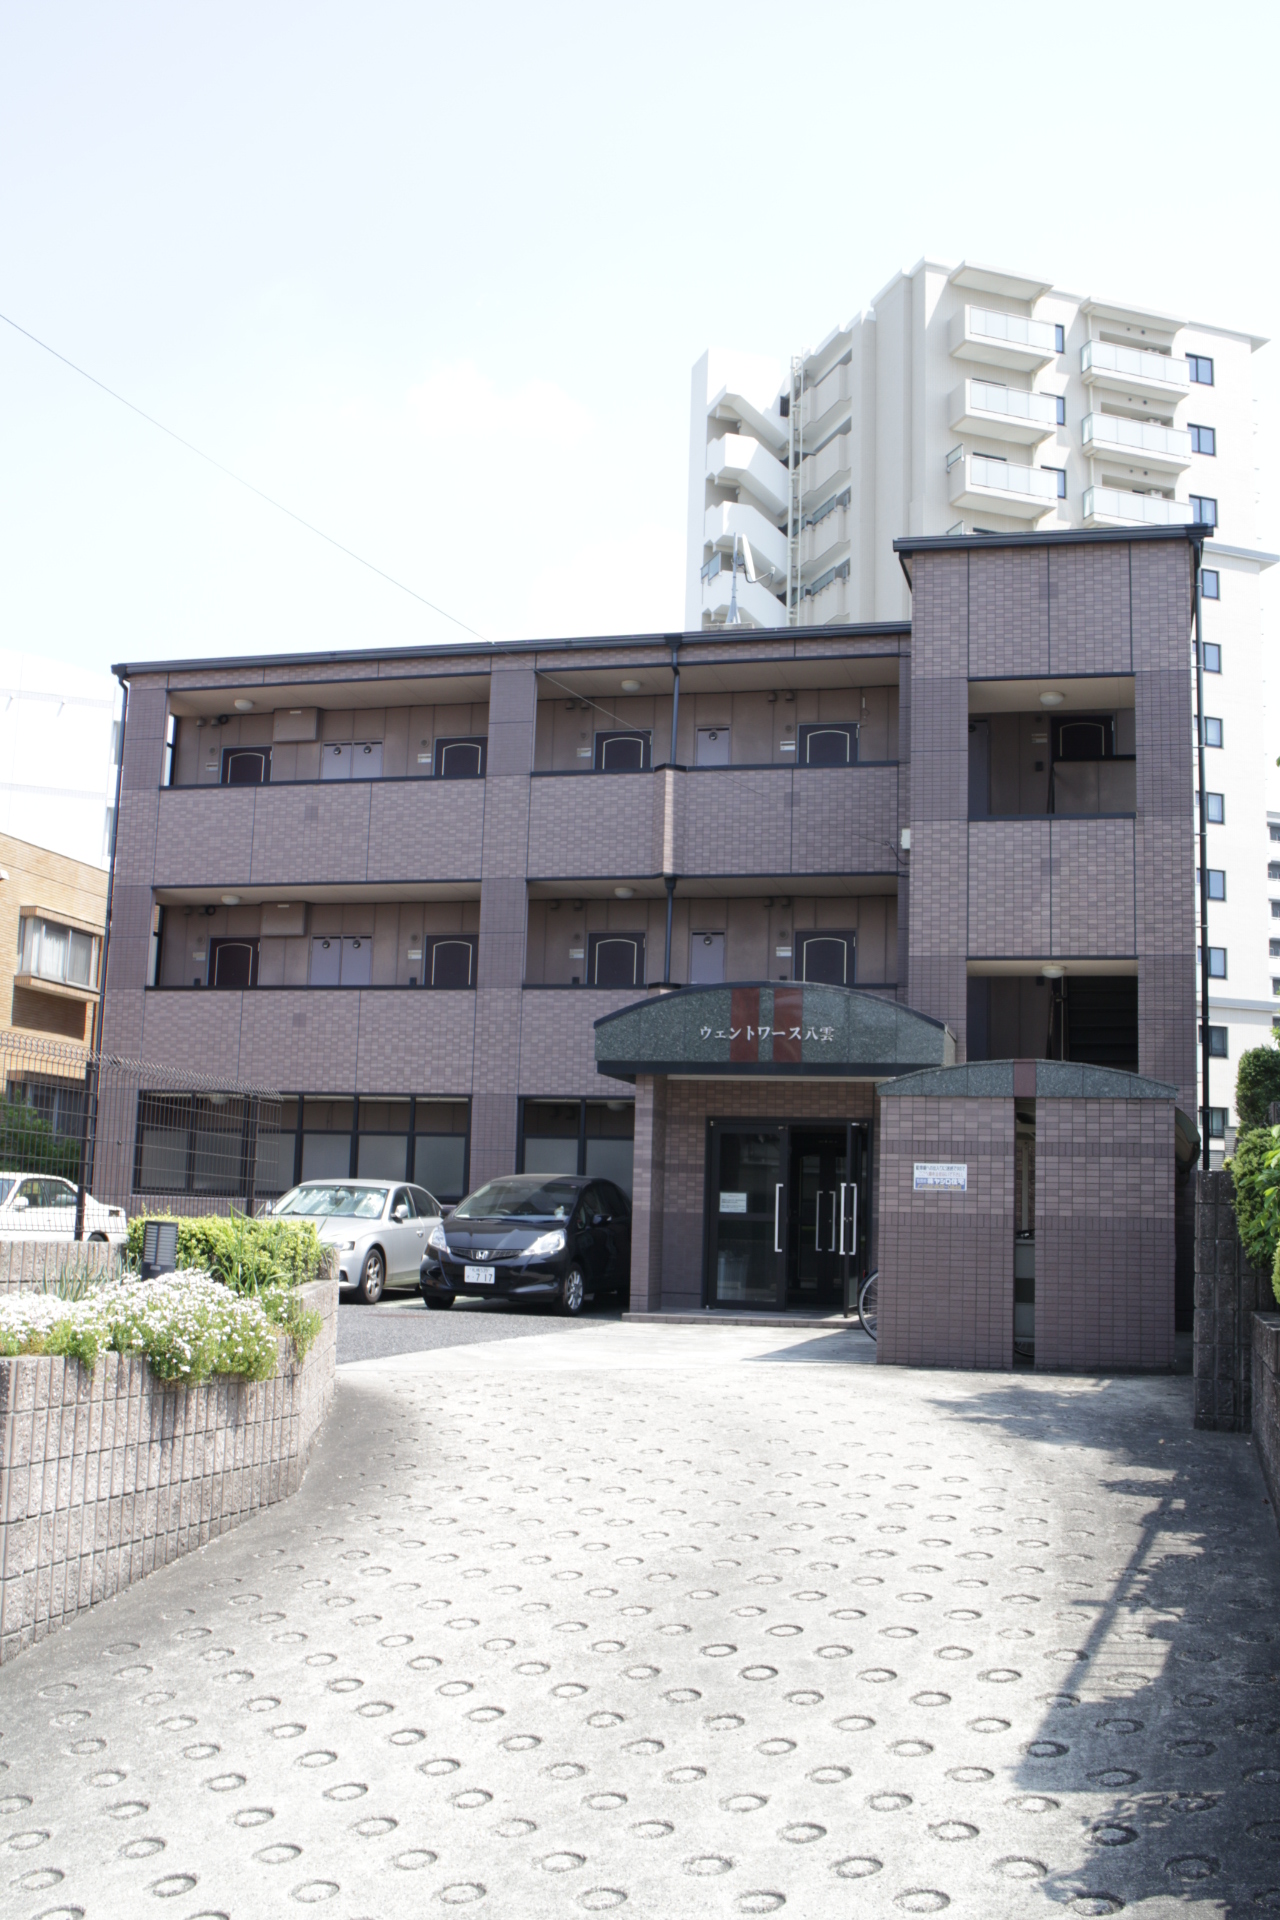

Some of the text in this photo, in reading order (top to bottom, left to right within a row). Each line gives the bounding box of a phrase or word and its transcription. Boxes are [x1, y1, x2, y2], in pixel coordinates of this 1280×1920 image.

[700, 1025, 834, 1041] ウェントワース八雲
